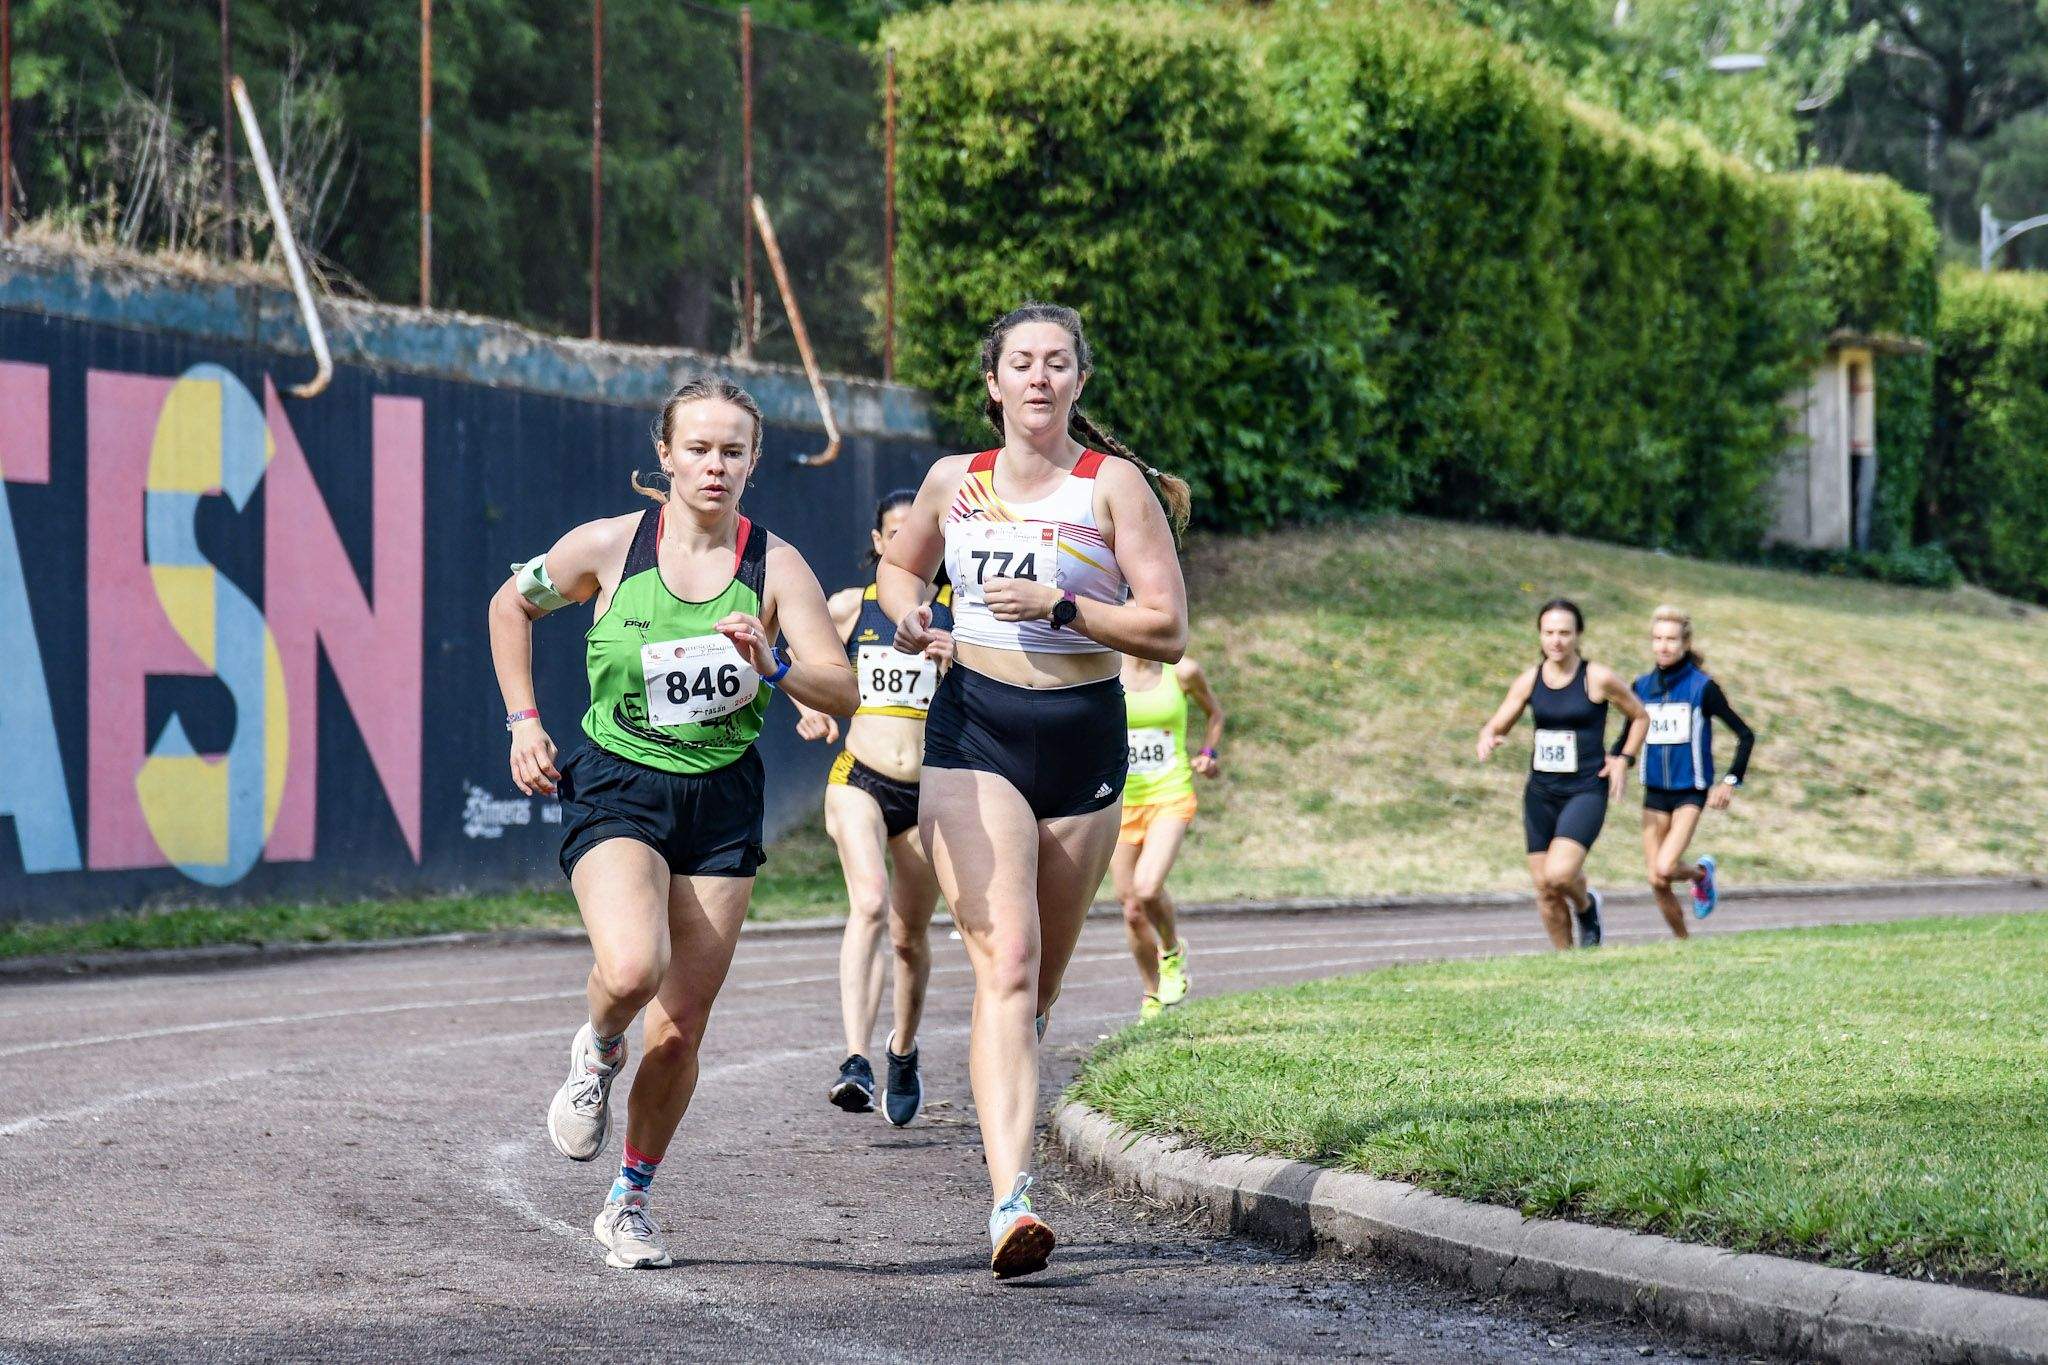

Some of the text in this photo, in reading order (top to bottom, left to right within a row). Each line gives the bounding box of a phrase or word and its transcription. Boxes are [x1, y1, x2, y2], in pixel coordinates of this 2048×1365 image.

[971, 550, 1037, 585] 774
[666, 664, 740, 705] 846
[872, 668, 921, 694] 887
[1128, 745, 1164, 764] 848
